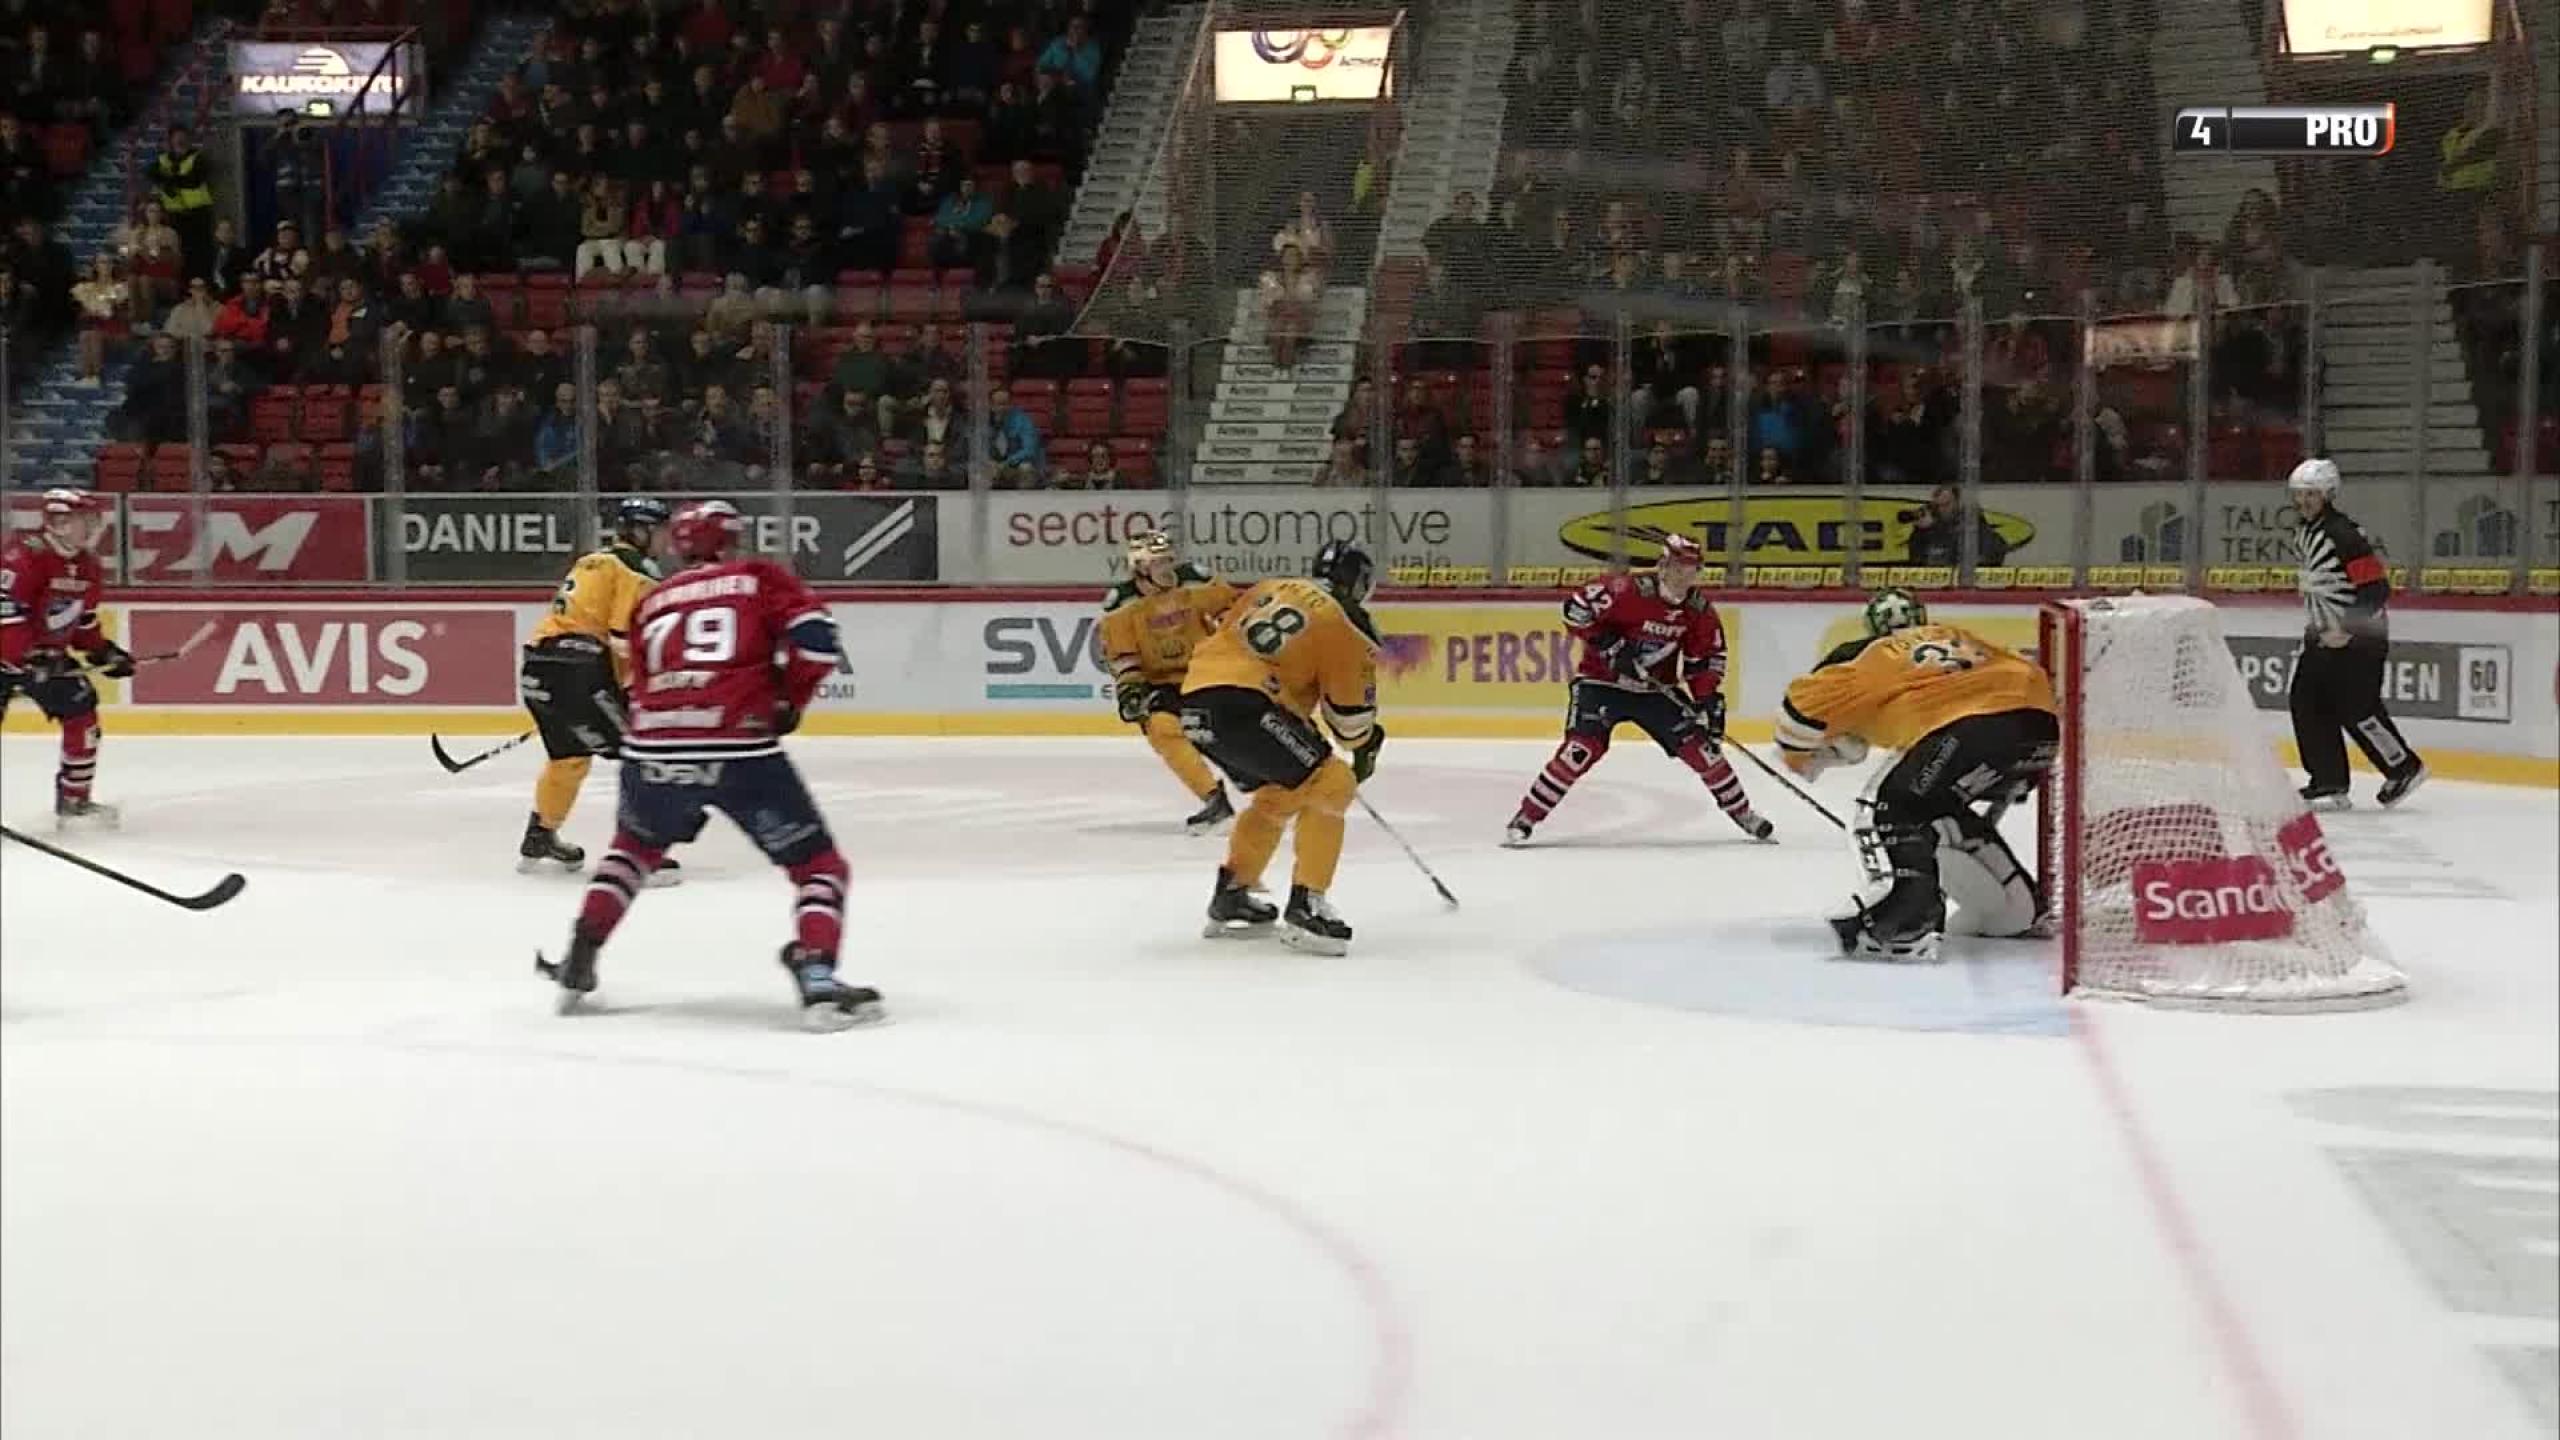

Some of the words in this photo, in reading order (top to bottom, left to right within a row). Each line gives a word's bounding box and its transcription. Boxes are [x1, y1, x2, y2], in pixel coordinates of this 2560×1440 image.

[400, 513, 573, 553] DANIEL
[214, 620, 430, 694] AVIS
[642, 607, 737, 673] 79
